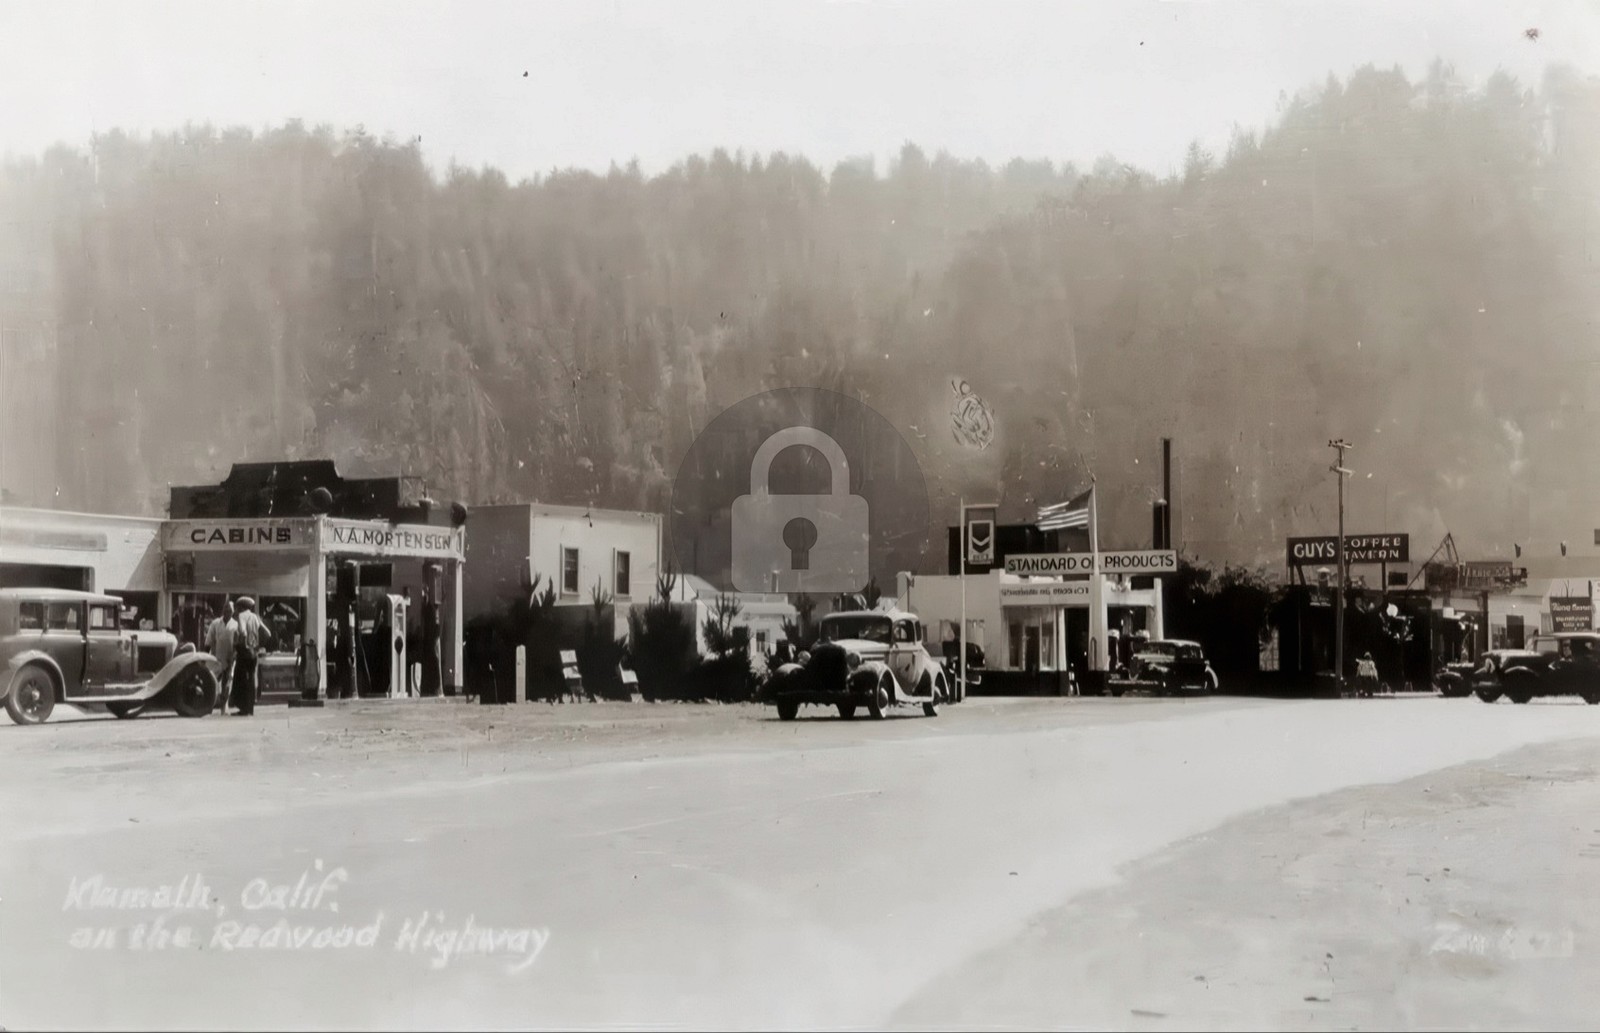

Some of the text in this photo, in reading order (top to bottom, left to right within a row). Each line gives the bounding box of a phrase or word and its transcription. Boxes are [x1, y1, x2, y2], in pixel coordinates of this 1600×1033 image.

[191, 527, 291, 544] CABINS
[1293, 540, 1336, 558] GUY'S
[1008, 556, 1077, 573] STANDARD
[1104, 554, 1174, 568] PRODUCTS
